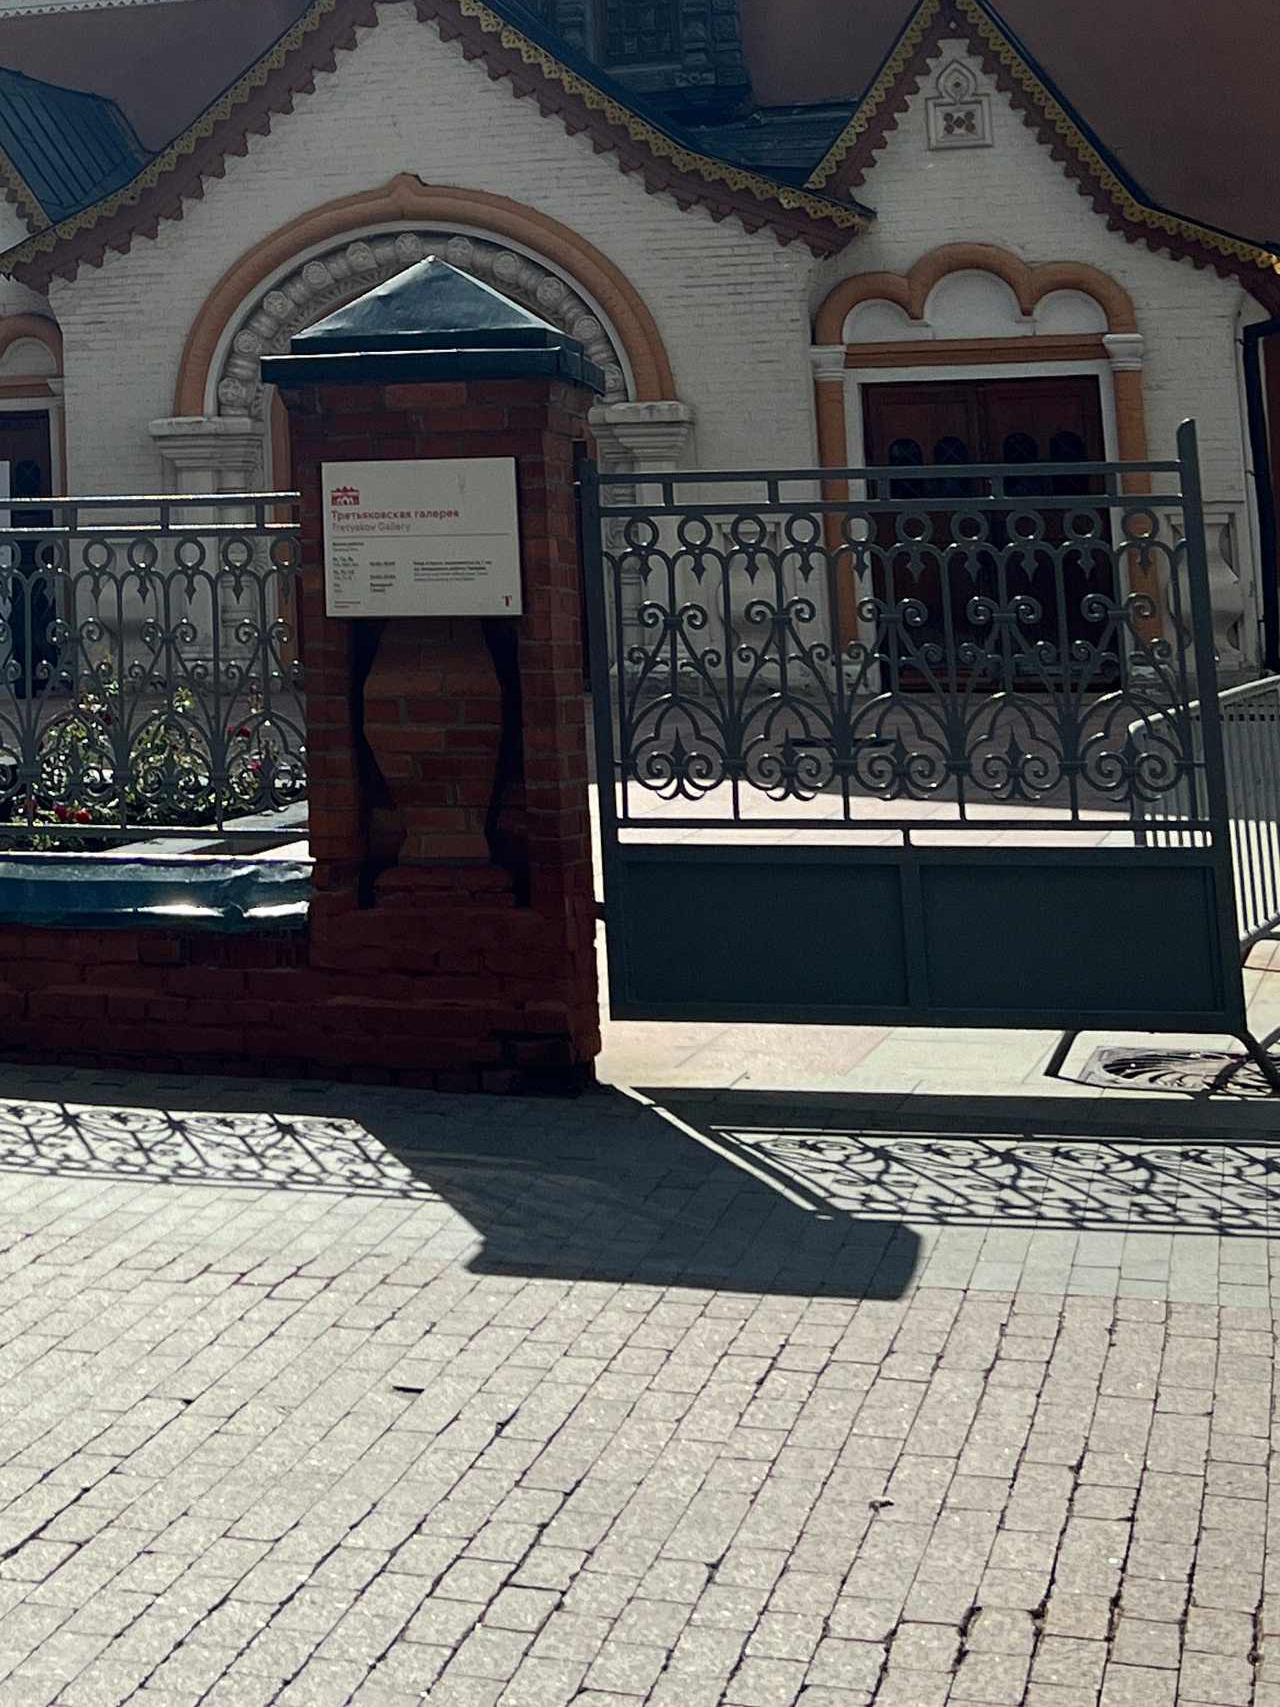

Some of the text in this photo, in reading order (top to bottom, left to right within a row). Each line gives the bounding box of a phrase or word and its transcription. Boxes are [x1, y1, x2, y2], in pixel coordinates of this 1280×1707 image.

[331, 509, 459, 522] Третьяковская галерея
[332, 522, 411, 533] Tretyakov Gallery
